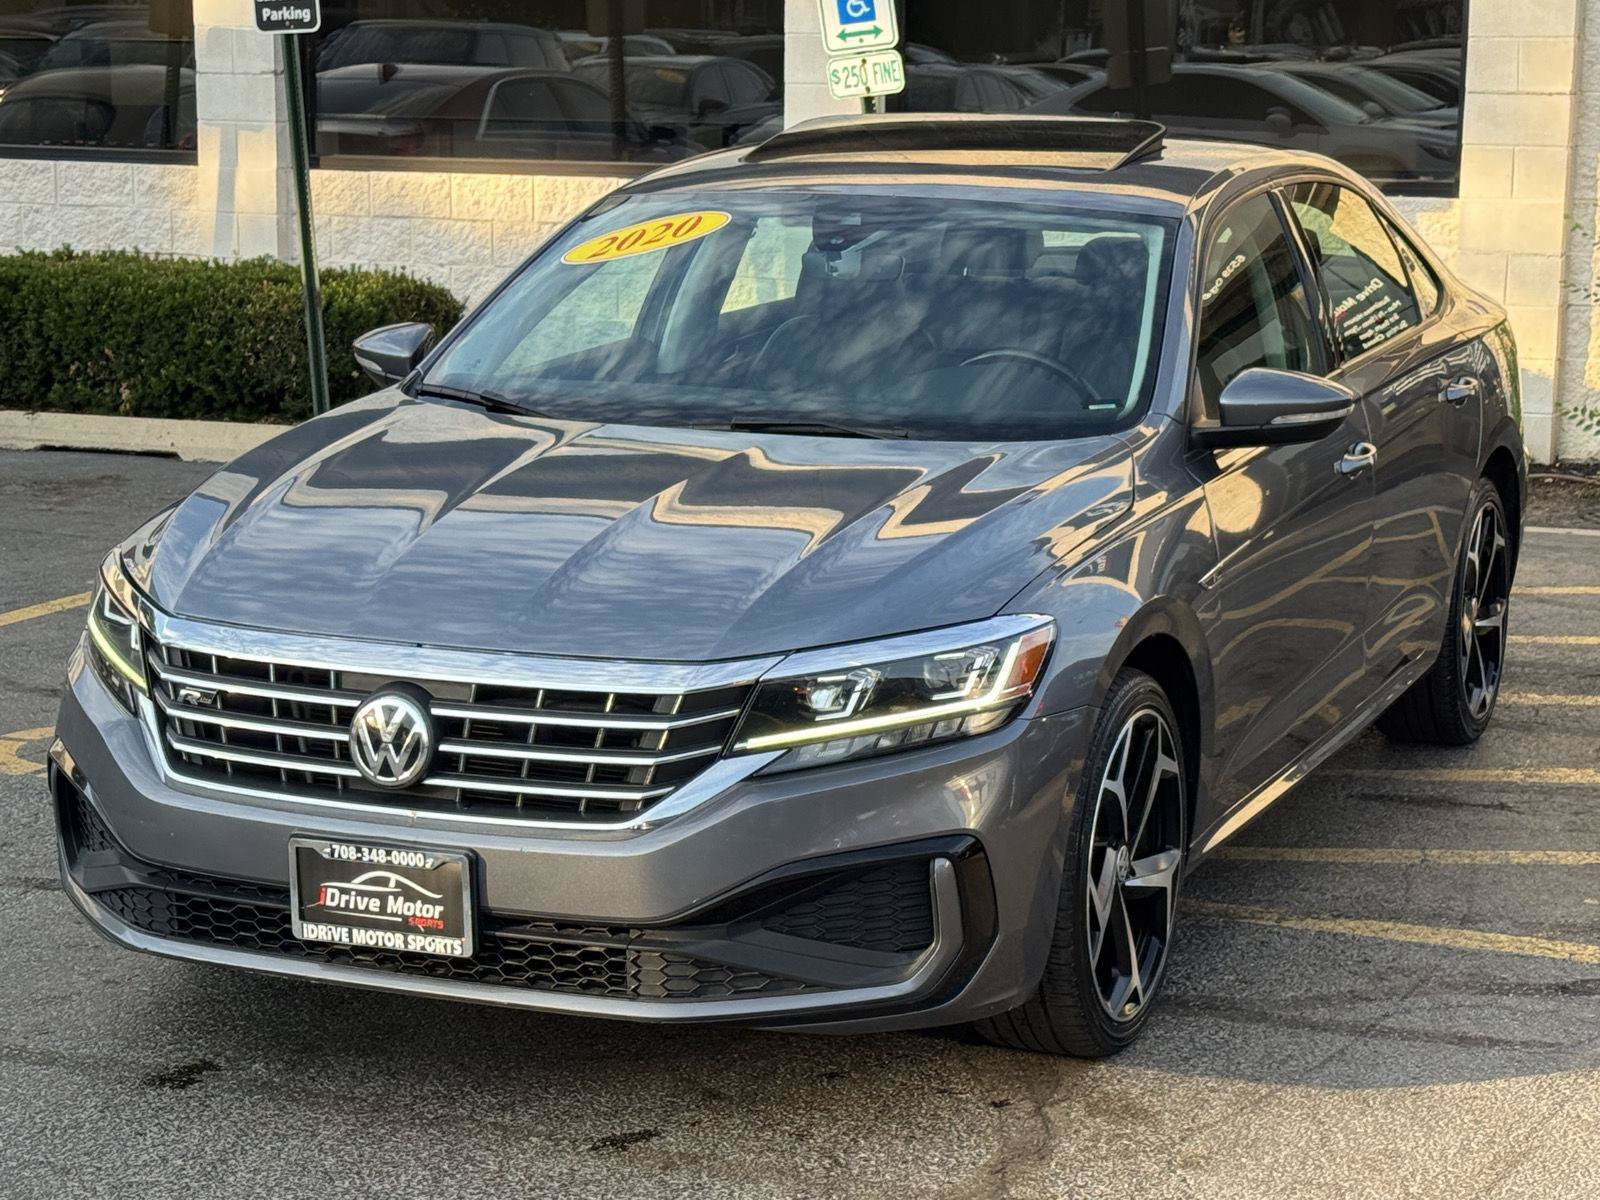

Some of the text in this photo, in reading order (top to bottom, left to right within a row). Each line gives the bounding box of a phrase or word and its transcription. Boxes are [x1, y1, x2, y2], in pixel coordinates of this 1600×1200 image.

[262, 5, 311, 23] Parking
[872, 60, 900, 85] FINE
[587, 215, 703, 260] 2020
[331, 844, 425, 868] 708-348-0000
[319, 887, 445, 919] iDrive Motor
[407, 916, 445, 930] SPORTS
[352, 927, 405, 950] MOTOR
[407, 934, 463, 956] SPORTS
